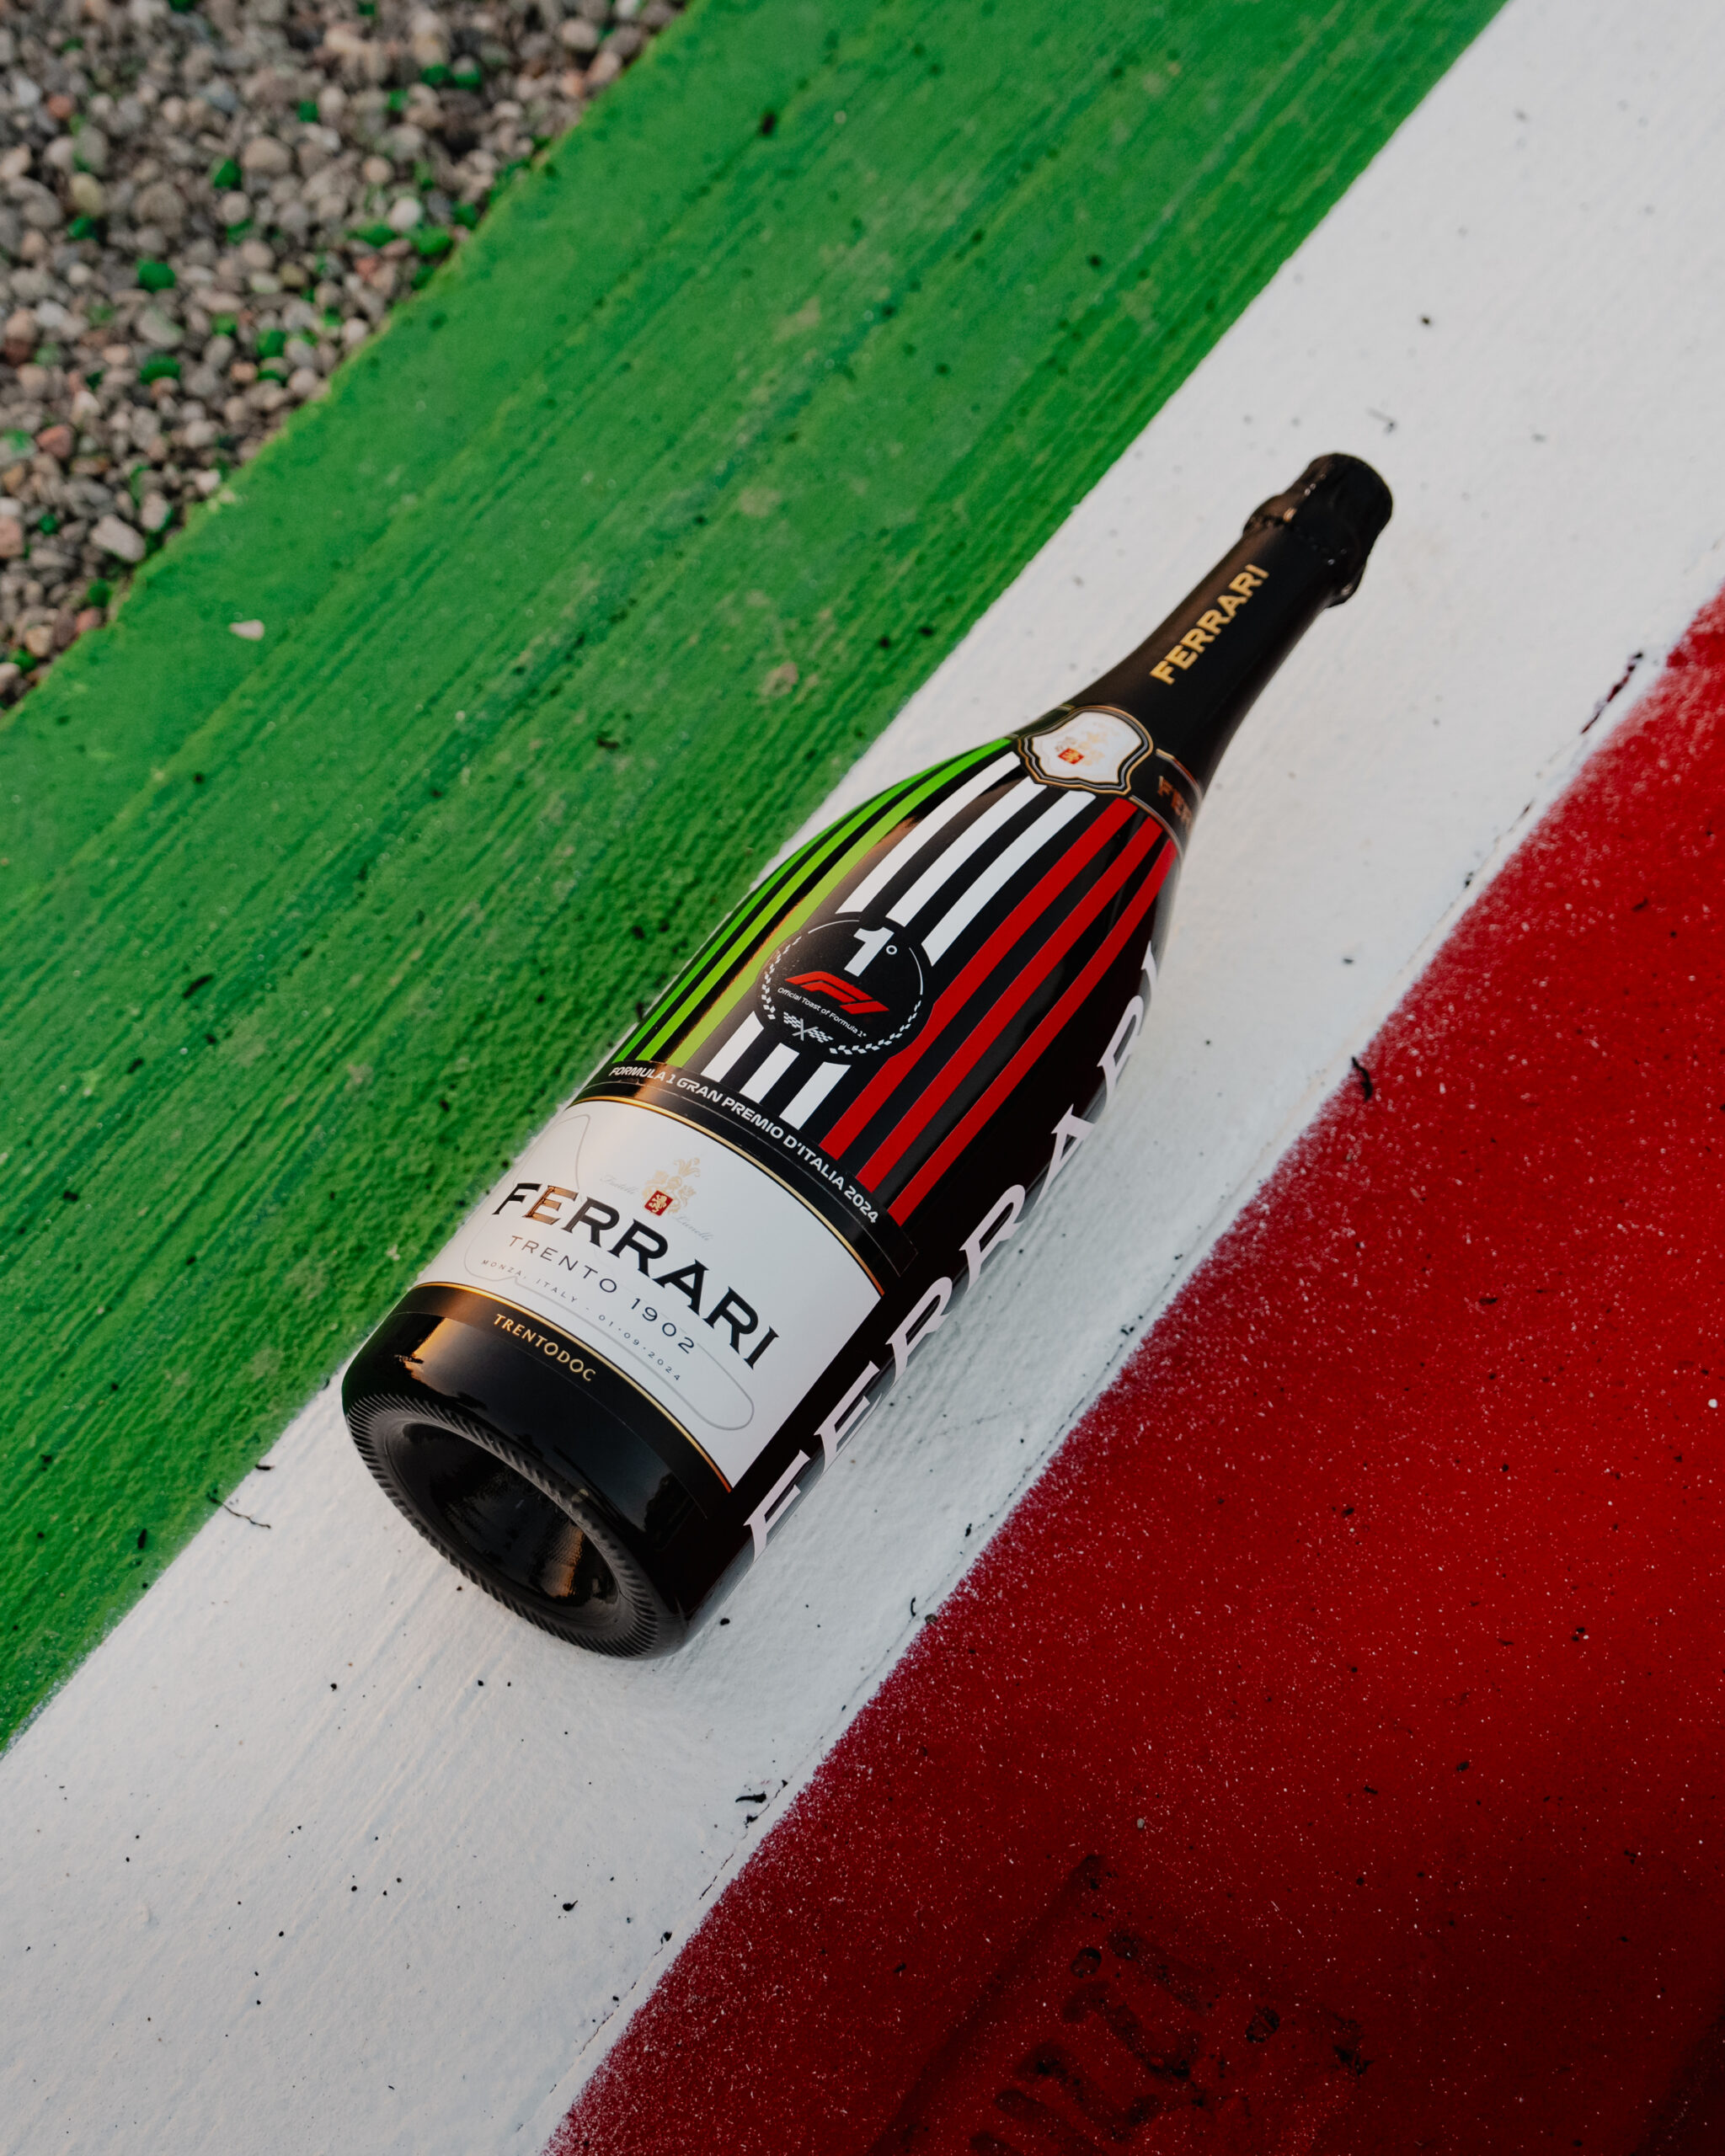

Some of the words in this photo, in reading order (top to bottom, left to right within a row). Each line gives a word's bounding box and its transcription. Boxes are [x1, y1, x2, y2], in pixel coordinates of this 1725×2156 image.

[1149, 563, 1269, 686] FERRARI
[777, 987, 803, 1004] Official
[802, 996, 820, 1011] Toast
[820, 1006, 830, 1015] of
[828, 1013, 858, 1033] Formula
[609, 1067, 665, 1082] FORMULA
[665, 1074, 675, 1085] 1
[676, 1079, 724, 1103] GRAN
[721, 1097, 784, 1139] PREMIO
[782, 1134, 846, 1191] D'ITALIA
[844, 1185, 880, 1224] 2024
[492, 1182, 780, 1370] FERRARI
[508, 1235, 617, 1294] TRENTO
[631, 1298, 695, 1354] 1902
[535, 1278, 578, 1303] ITALY
[493, 1314, 596, 1382] TRENTODOC
